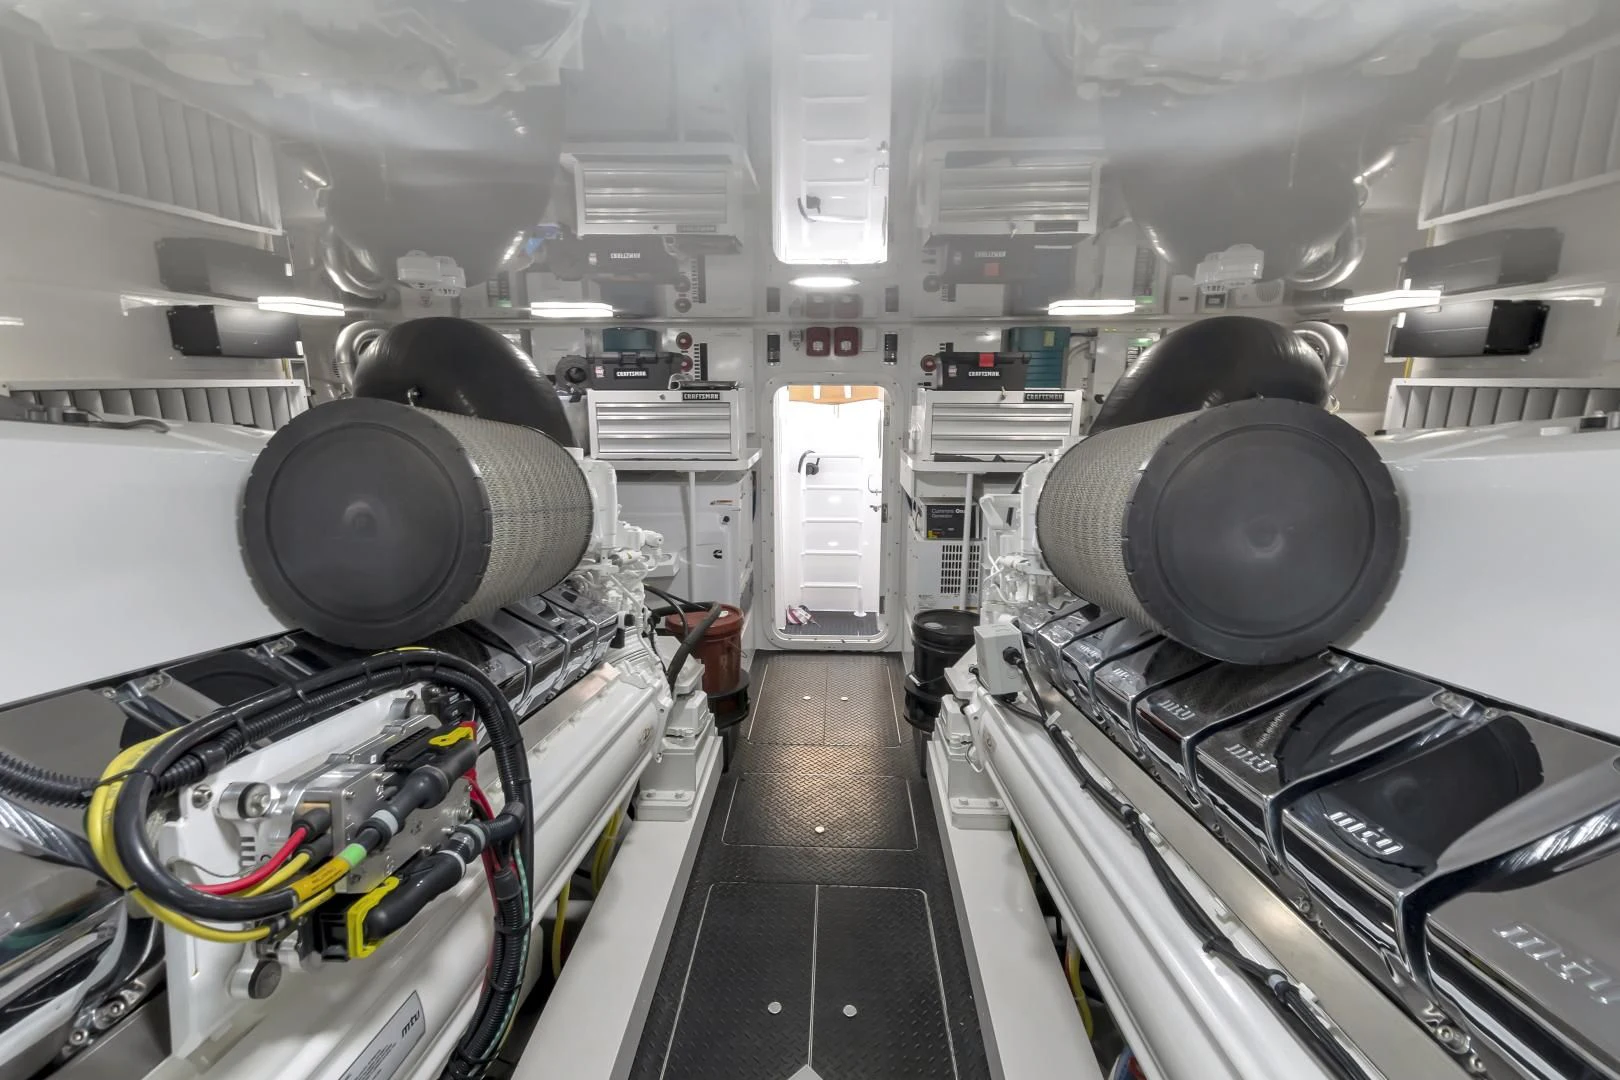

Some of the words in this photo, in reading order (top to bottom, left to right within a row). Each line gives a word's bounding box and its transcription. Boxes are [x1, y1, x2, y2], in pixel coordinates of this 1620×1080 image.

[1224, 743, 1278, 773] mtu
[1323, 811, 1404, 856] mtu
[401, 1009, 420, 1039] mtu
